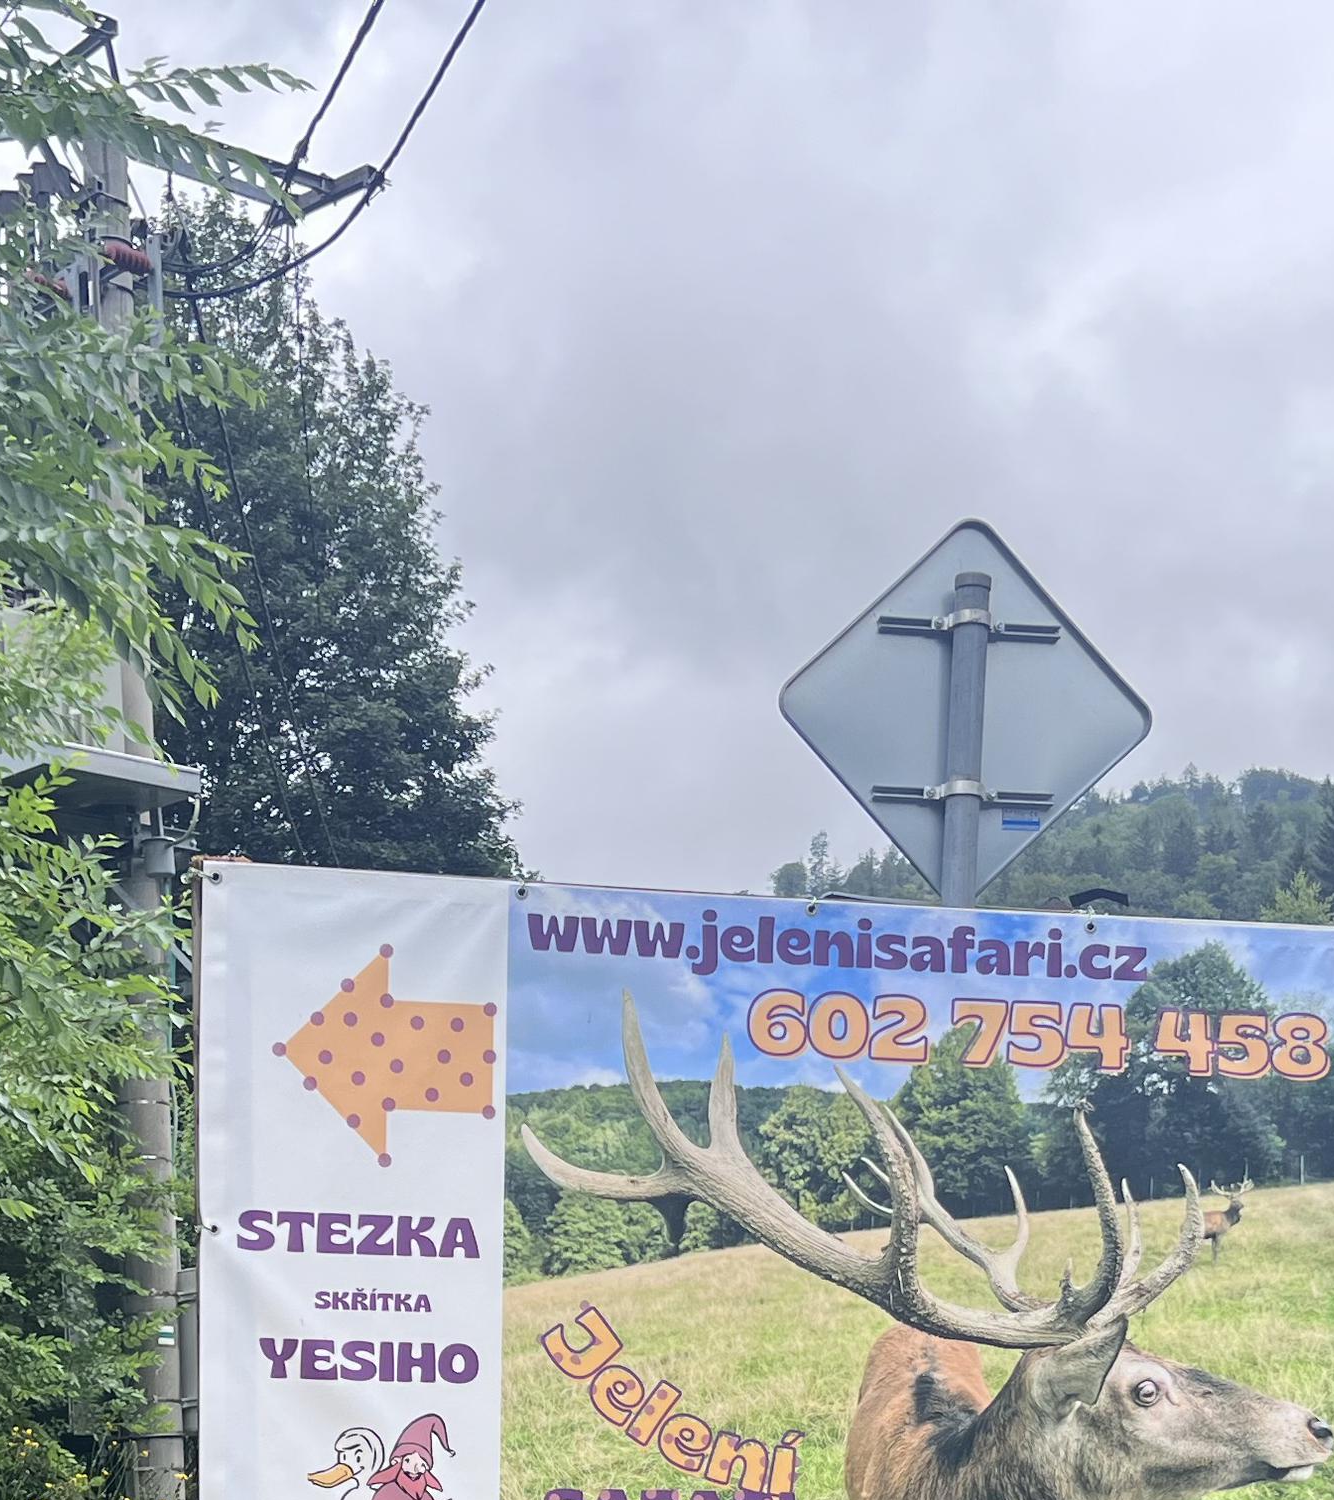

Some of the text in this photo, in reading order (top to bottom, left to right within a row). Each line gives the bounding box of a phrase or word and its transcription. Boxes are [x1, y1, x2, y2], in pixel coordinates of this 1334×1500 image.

[527, 909, 1147, 981] www.jelenisafari.cz
[746, 988, 1330, 1082] 602 754 458
[236, 1209, 481, 1259] STEZKA
[314, 1287, 432, 1312] SKŘÍTKA
[259, 1337, 479, 1384] YESIHO
[539, 1303, 805, 1497] Jelení
